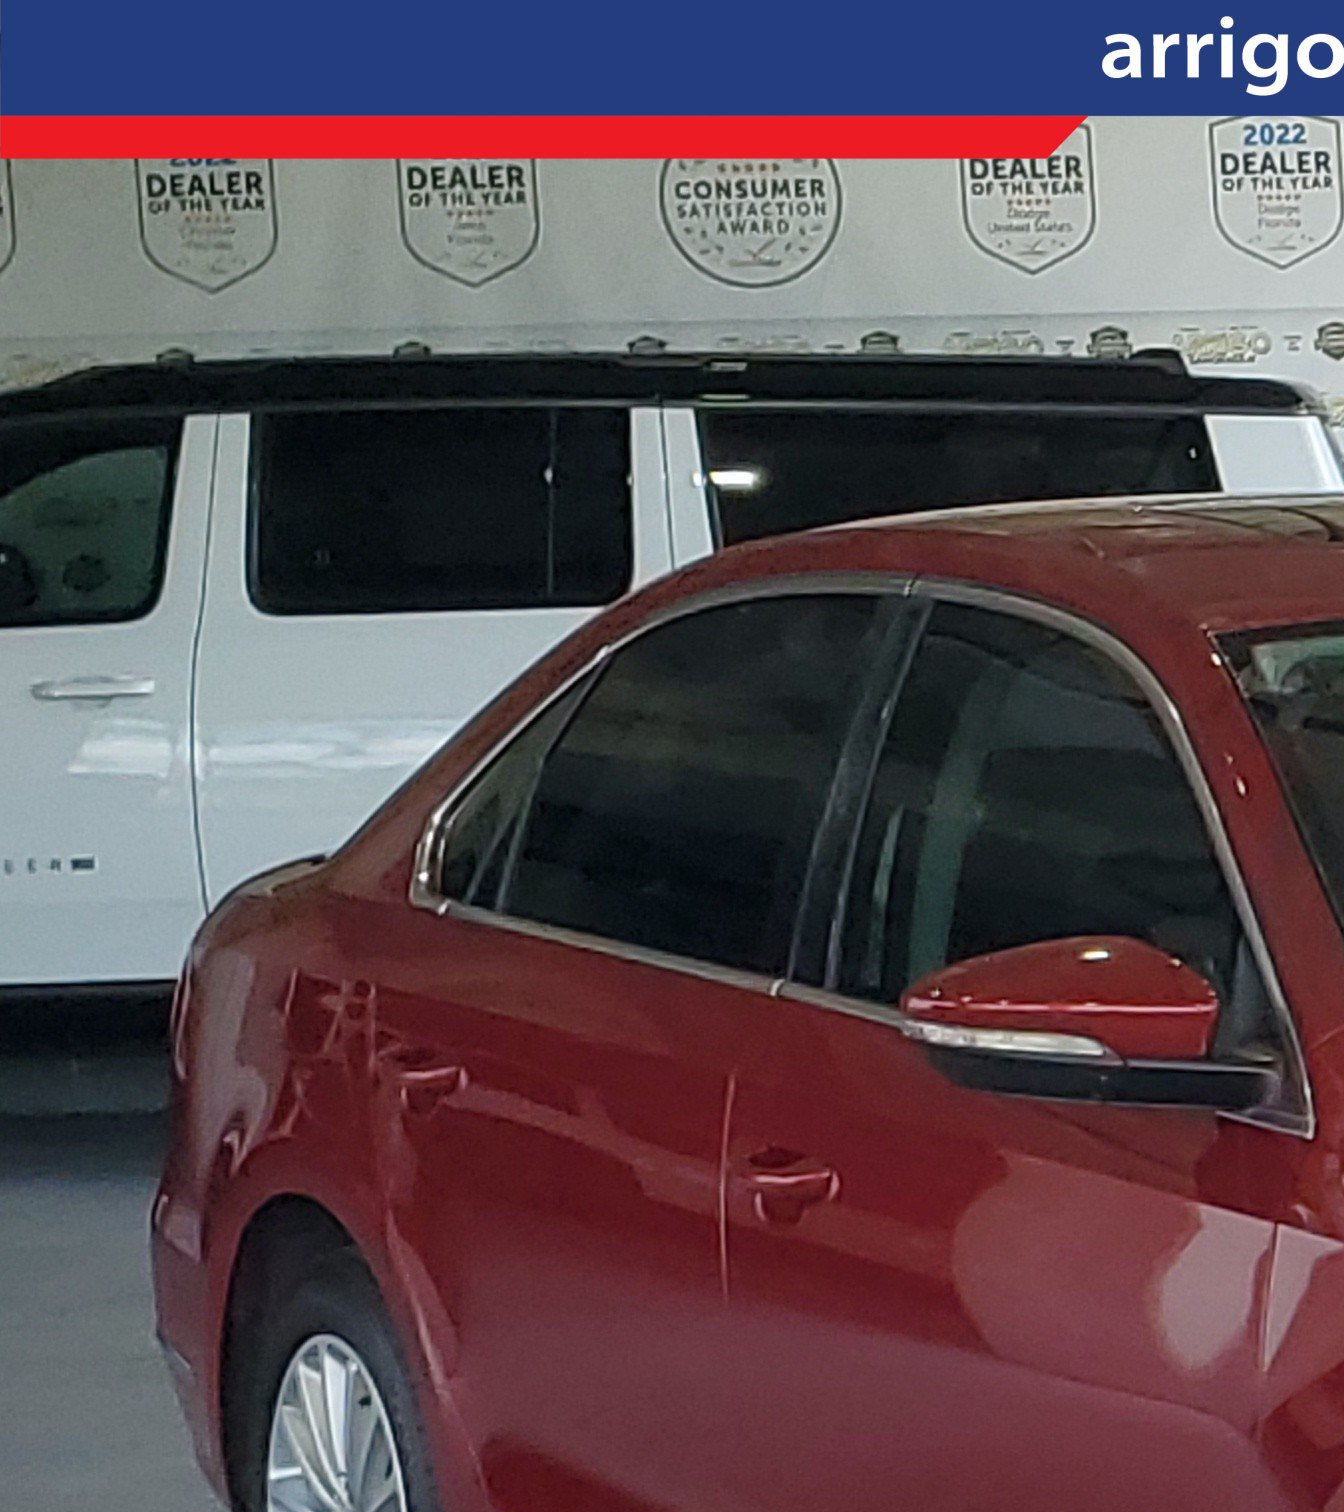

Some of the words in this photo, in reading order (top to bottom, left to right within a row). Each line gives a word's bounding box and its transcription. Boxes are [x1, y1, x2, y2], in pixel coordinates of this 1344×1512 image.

[1243, 123, 1307, 146] 2022
[969, 156, 1082, 180] DEALER
[1220, 151, 1331, 175] DEALER
[145, 171, 264, 198] DEALER
[407, 165, 525, 190] DEALER
[971, 182, 994, 195] OF
[1000, 181, 1034, 195] THE
[1040, 181, 1084, 195] YEAR
[1221, 177, 1244, 191] OF
[1250, 177, 1284, 190] THE
[1290, 176, 1333, 190] YEAR
[675, 178, 825, 200] CONSUMER
[677, 201, 827, 218] SATISFACTION
[717, 219, 790, 235] AWARD
